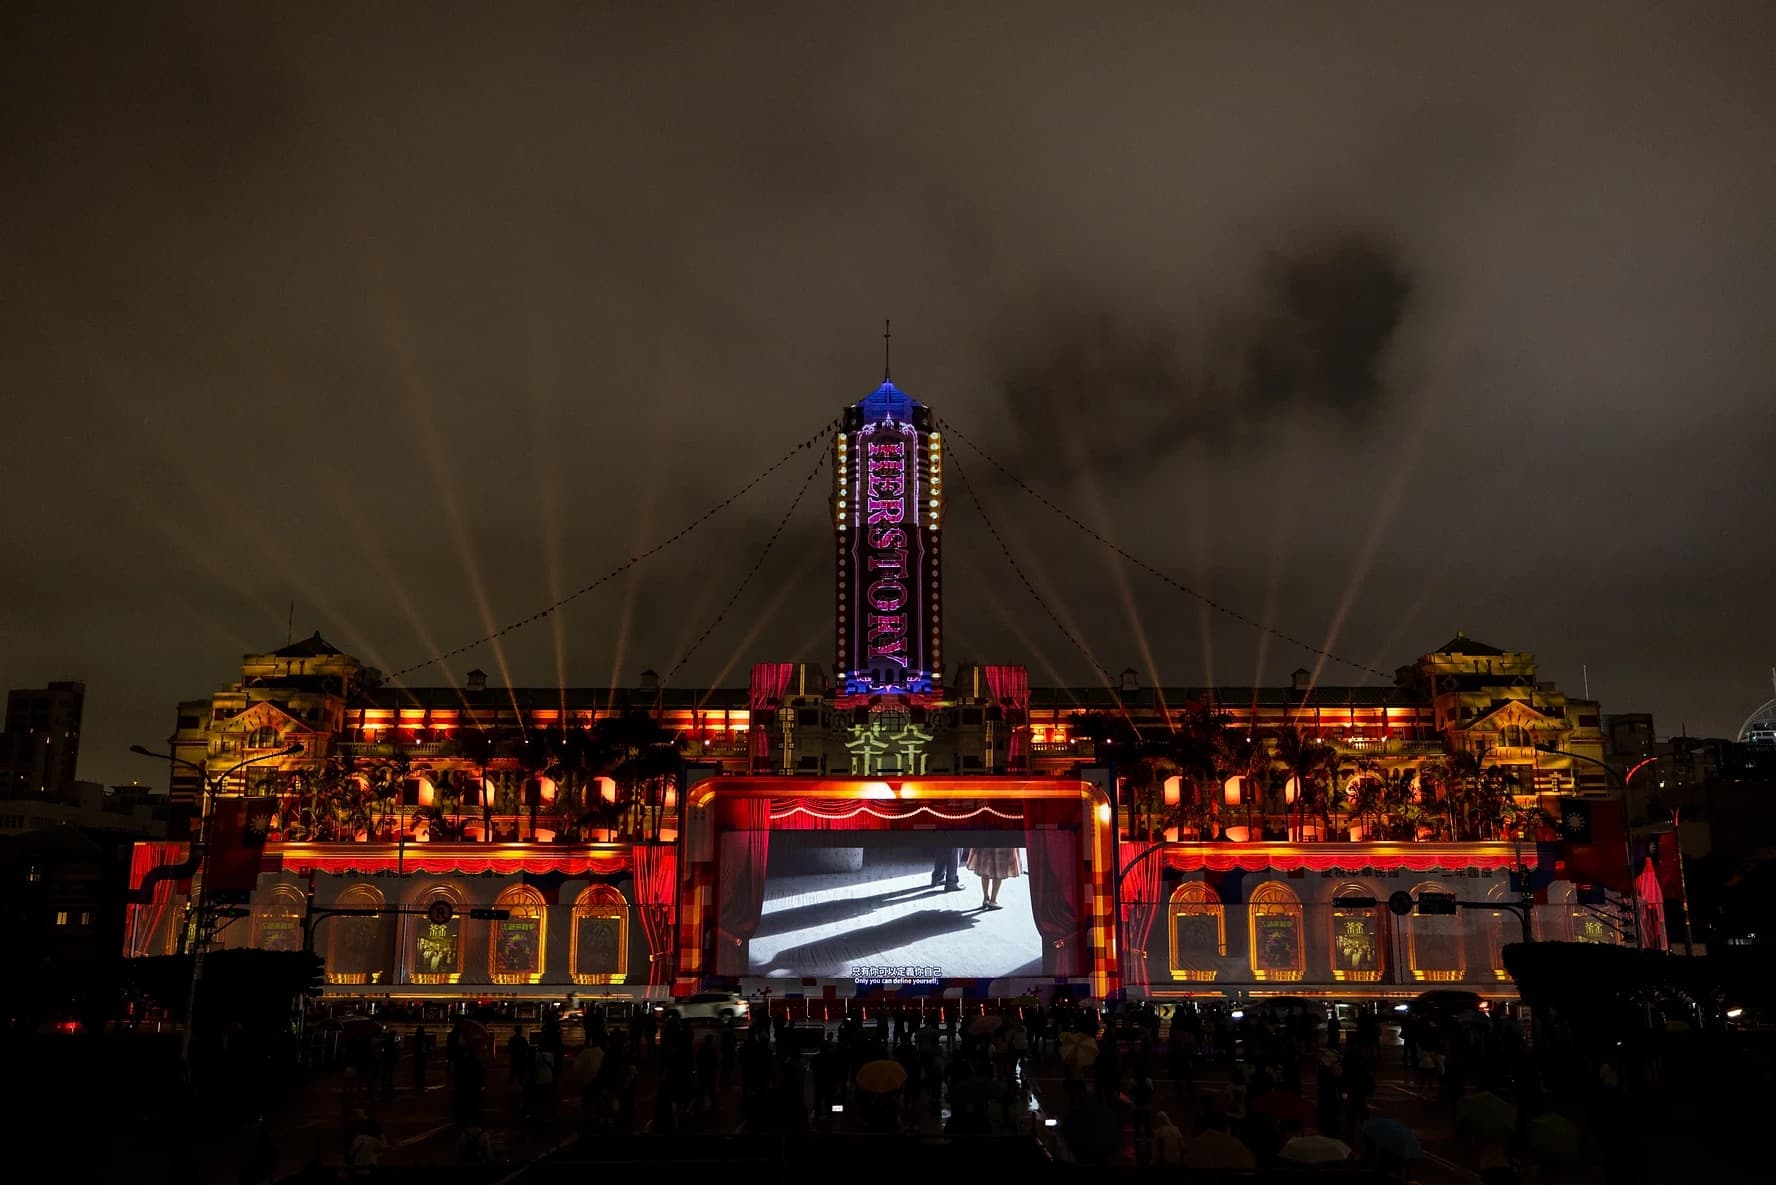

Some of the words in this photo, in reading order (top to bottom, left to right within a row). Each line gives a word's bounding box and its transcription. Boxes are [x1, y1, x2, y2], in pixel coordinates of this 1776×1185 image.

[866, 441, 910, 668] HERSTORY
[845, 720, 934, 777] 茶金
[852, 966, 941, 977] 只有你可以定義你自己
